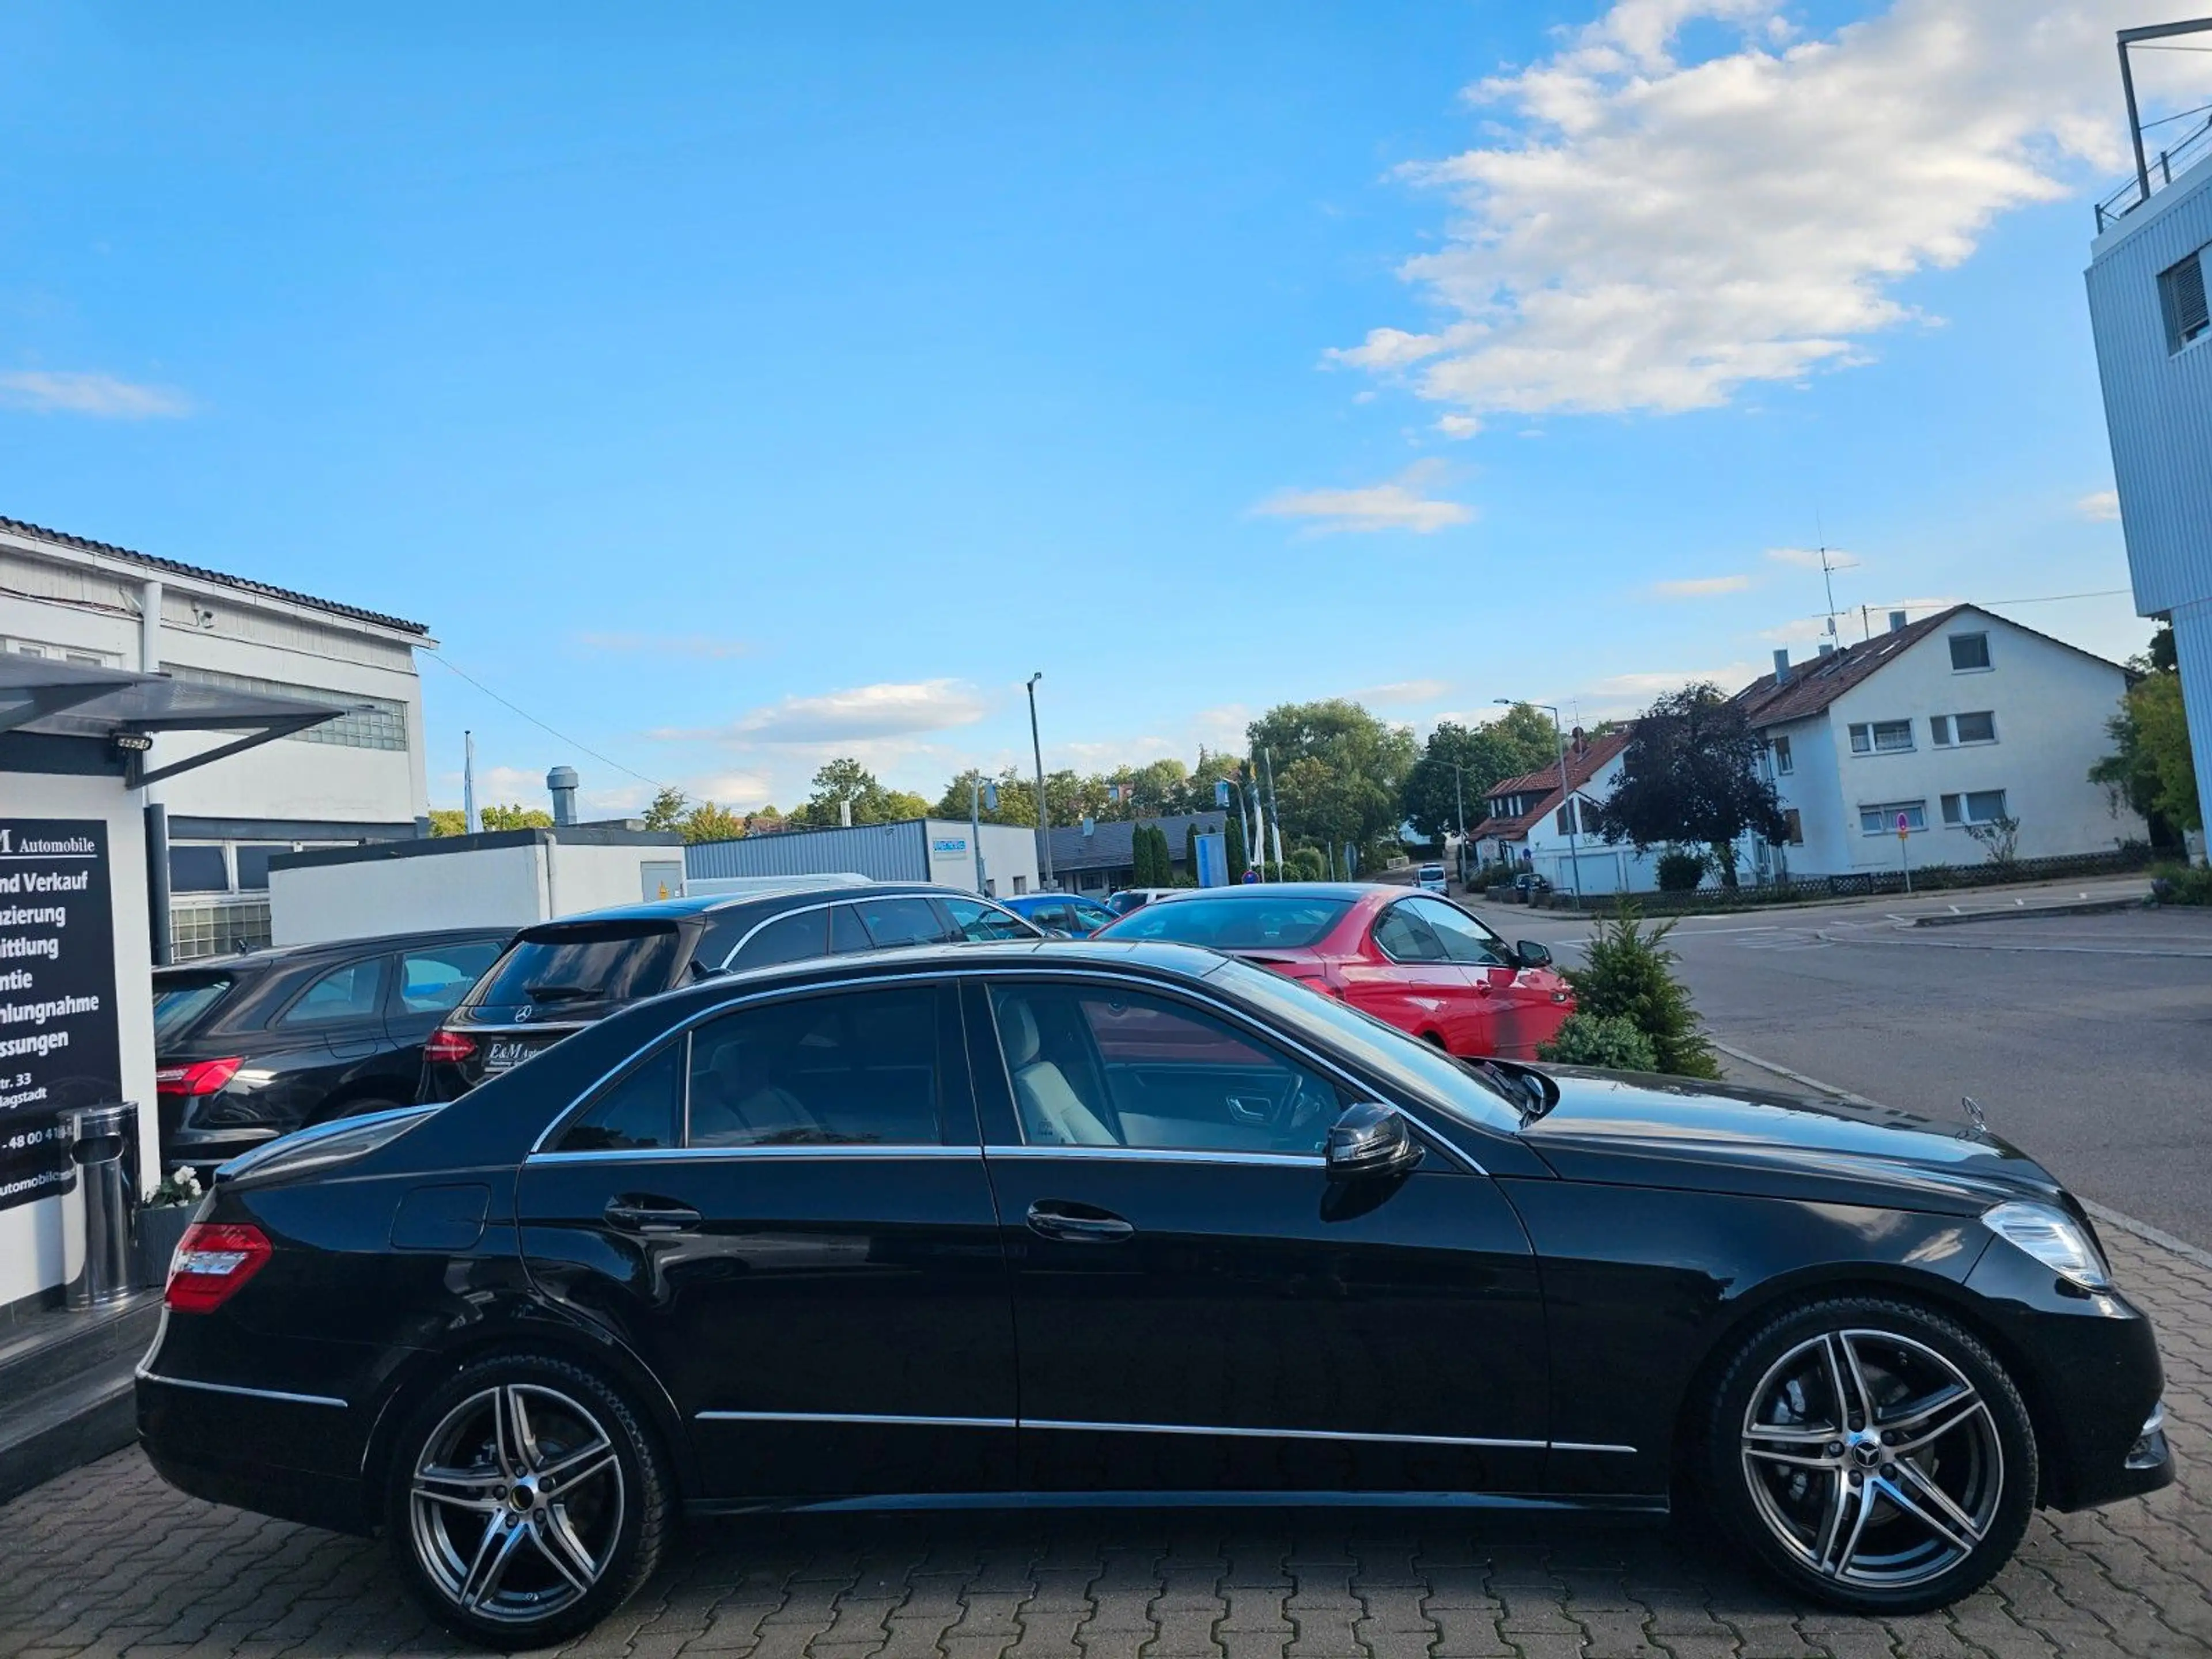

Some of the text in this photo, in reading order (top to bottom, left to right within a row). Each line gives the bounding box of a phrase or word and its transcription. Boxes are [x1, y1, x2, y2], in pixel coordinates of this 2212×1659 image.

[19, 838, 95, 853] Automobile
[23, 870, 88, 892] Verkauf
[0, 937, 58, 960] ittlung
[16, 1072, 32, 1087] 33
[9, 1135, 25, 1149] 48
[27, 1130, 43, 1145] 00
